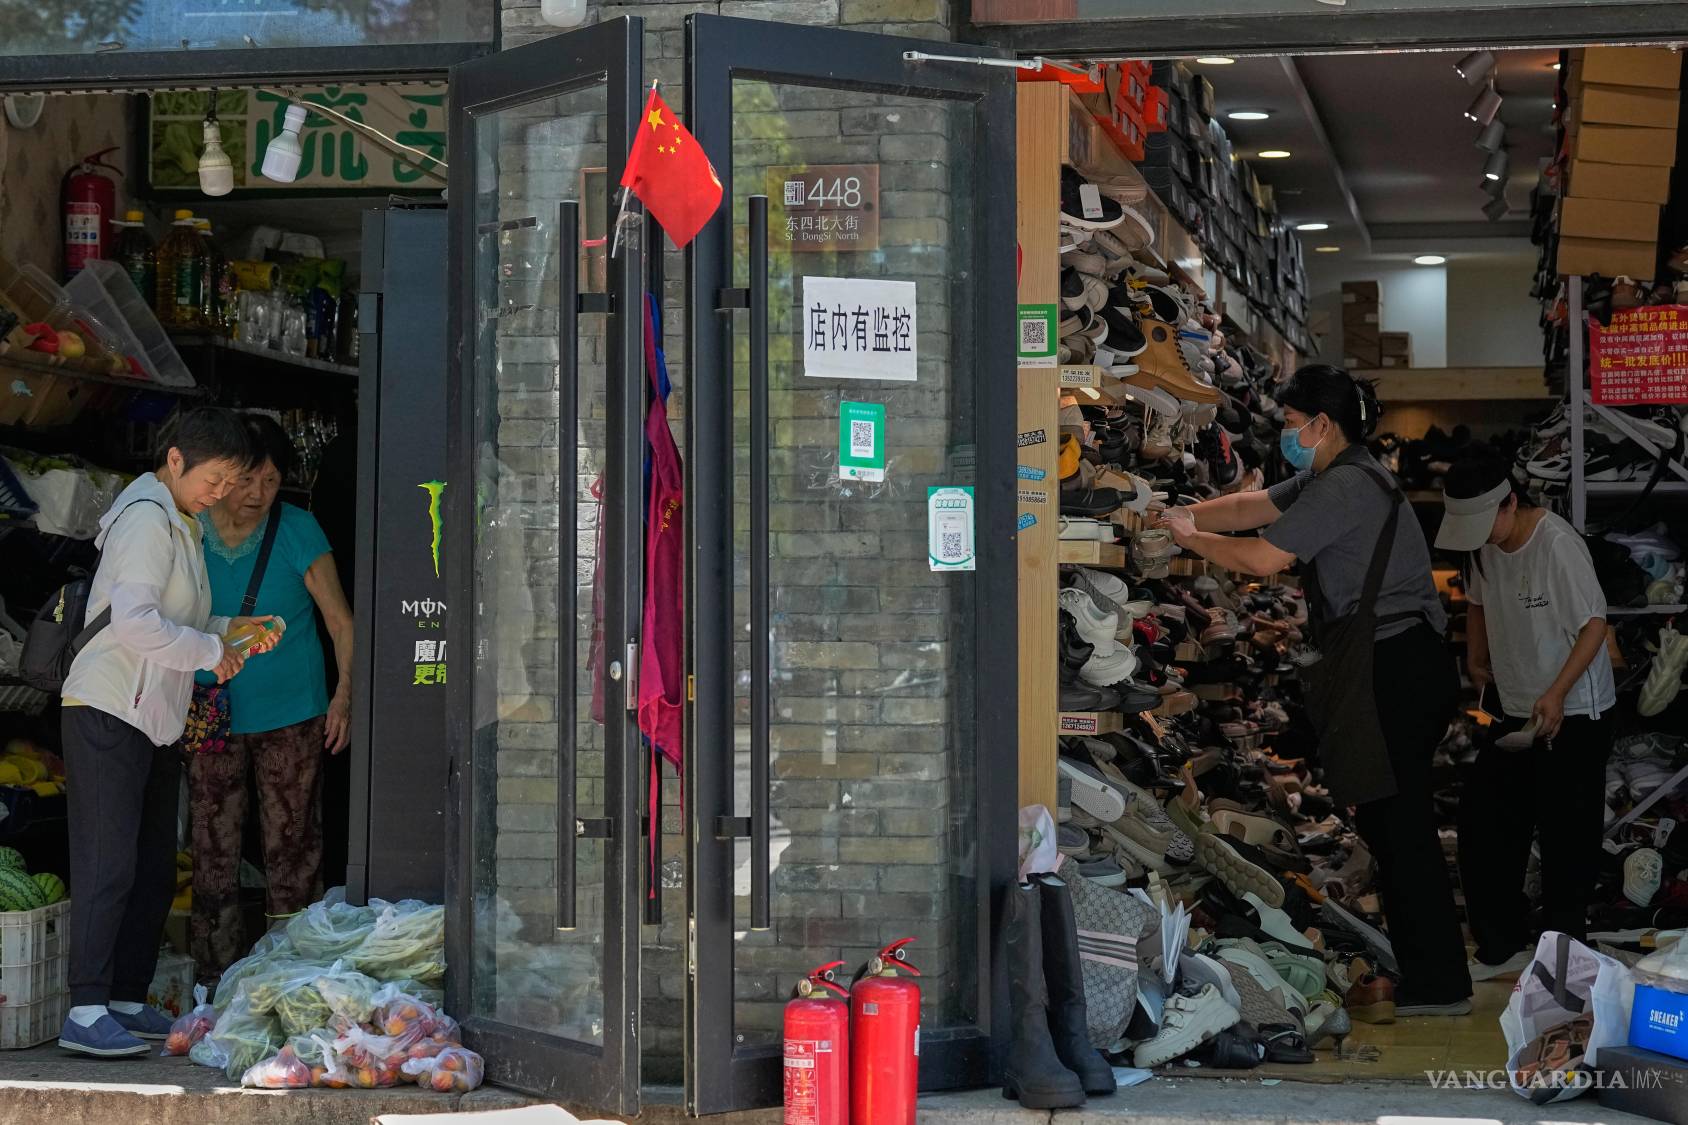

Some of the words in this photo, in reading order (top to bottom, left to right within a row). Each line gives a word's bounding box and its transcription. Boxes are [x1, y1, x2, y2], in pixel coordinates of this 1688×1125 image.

[807, 177, 861, 207] 448
[785, 215, 859, 231] 东四北大街
[785, 232, 796, 241] St.
[802, 231, 831, 242] DongSi
[836, 231, 859, 240] North
[808, 302, 912, 352] 店内有监控
[1650, 1009, 1679, 1028] SNEAKER
